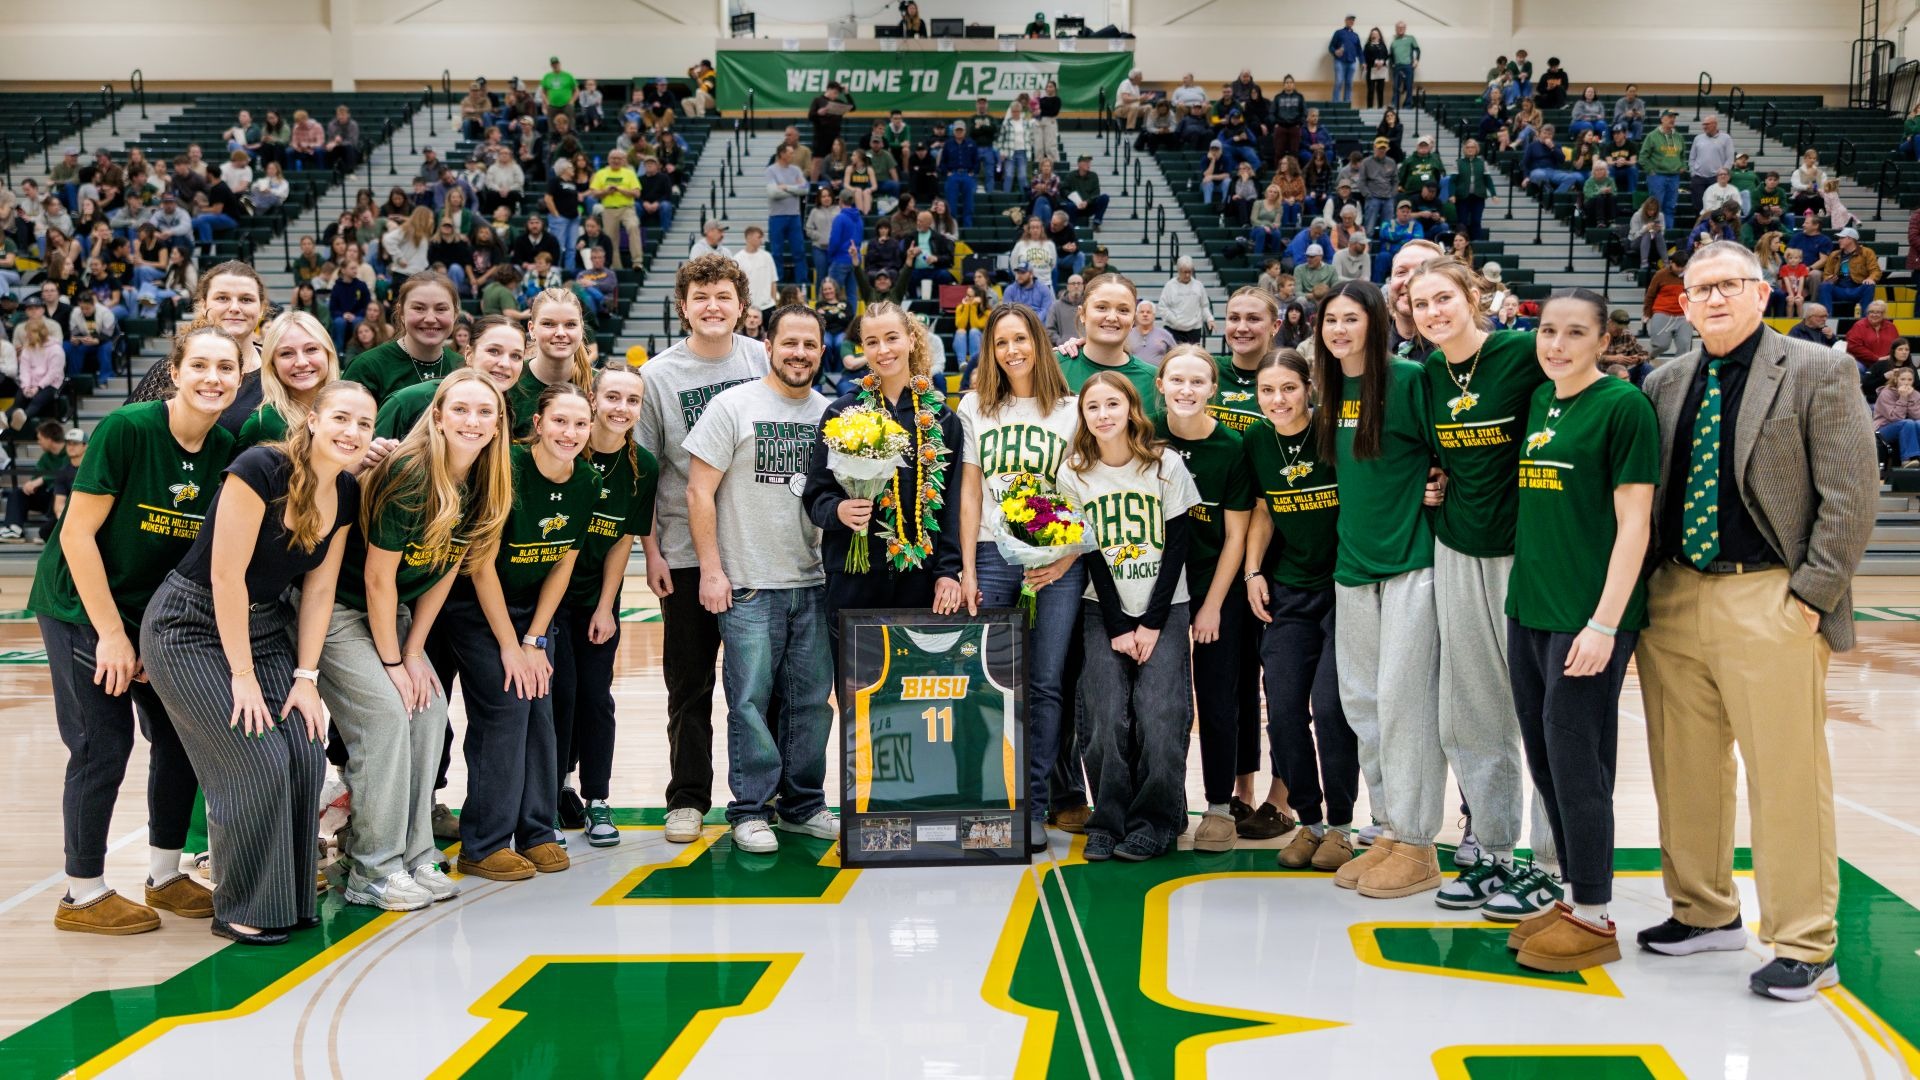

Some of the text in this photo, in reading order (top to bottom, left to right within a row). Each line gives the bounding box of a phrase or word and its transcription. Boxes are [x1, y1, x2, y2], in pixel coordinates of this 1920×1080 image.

[786, 69, 939, 93] WELCOME TO
[955, 66, 997, 96] A2
[1220, 412, 1237, 421] HILLS
[1455, 429, 1475, 439] HILLS
[1477, 426, 1501, 437] STATE
[979, 424, 1068, 484] BHSU
[1542, 468, 1558, 479] STATE
[1293, 494, 1313, 503] HILLS
[1315, 490, 1336, 501] STATE
[140, 521, 170, 535] WOMEN'S
[171, 517, 189, 528] HILLS
[596, 518, 616, 530] STATE
[519, 548, 540, 557] BLACK
[541, 547, 557, 556] HILLS
[511, 556, 540, 564] WOMEN'S
[900, 676, 970, 701] BHSU
[921, 706, 953, 743] 11
